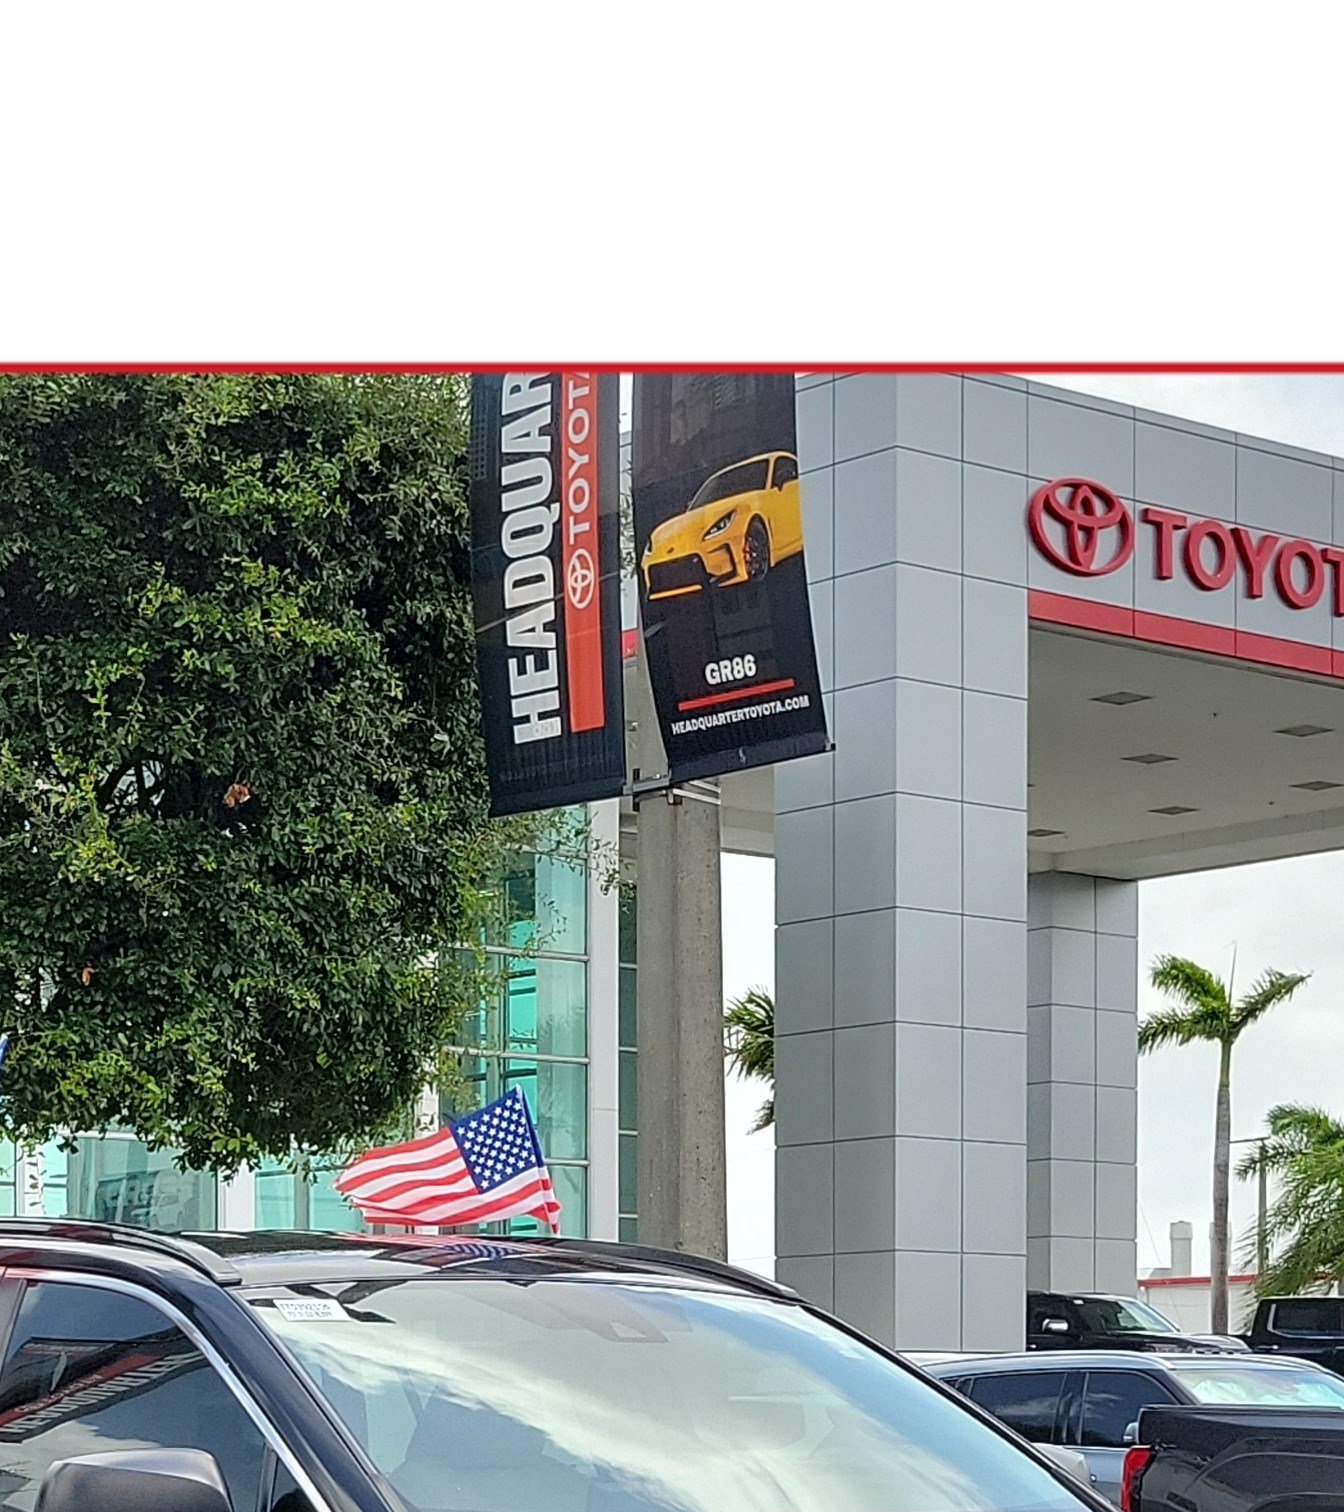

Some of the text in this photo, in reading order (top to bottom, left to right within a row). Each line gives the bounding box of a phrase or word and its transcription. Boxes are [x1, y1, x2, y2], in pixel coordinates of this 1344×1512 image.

[567, 373, 590, 545] TOYOT
[705, 654, 757, 685] GR86
[671, 695, 810, 736] HEADQUARTERTOYOTA.COM
